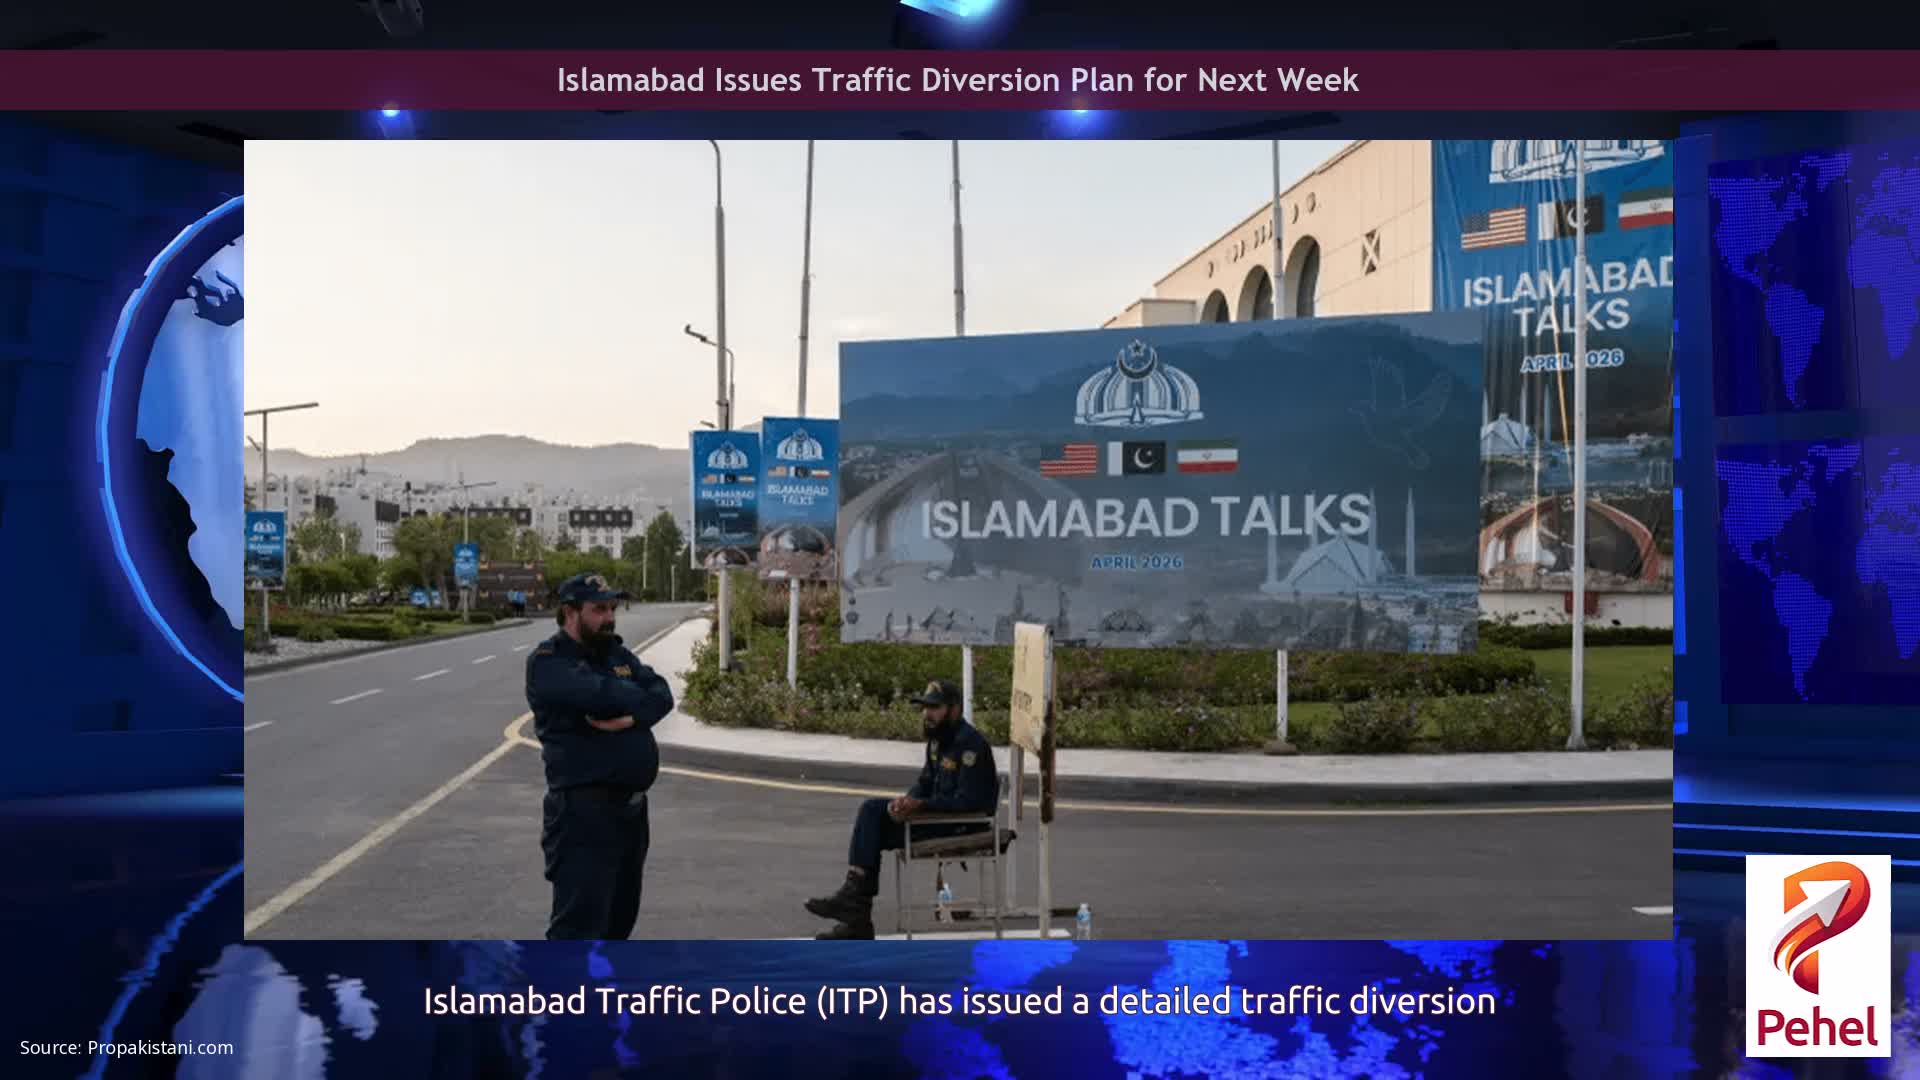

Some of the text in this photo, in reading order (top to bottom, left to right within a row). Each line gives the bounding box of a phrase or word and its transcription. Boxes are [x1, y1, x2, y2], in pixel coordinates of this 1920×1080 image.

[1512, 298, 1630, 337] TALKS
[1520, 348, 1624, 373] APRL 026
[922, 493, 1370, 539] ISLAMABAD TALKS
[1091, 555, 1183, 570] APRIL 2026
